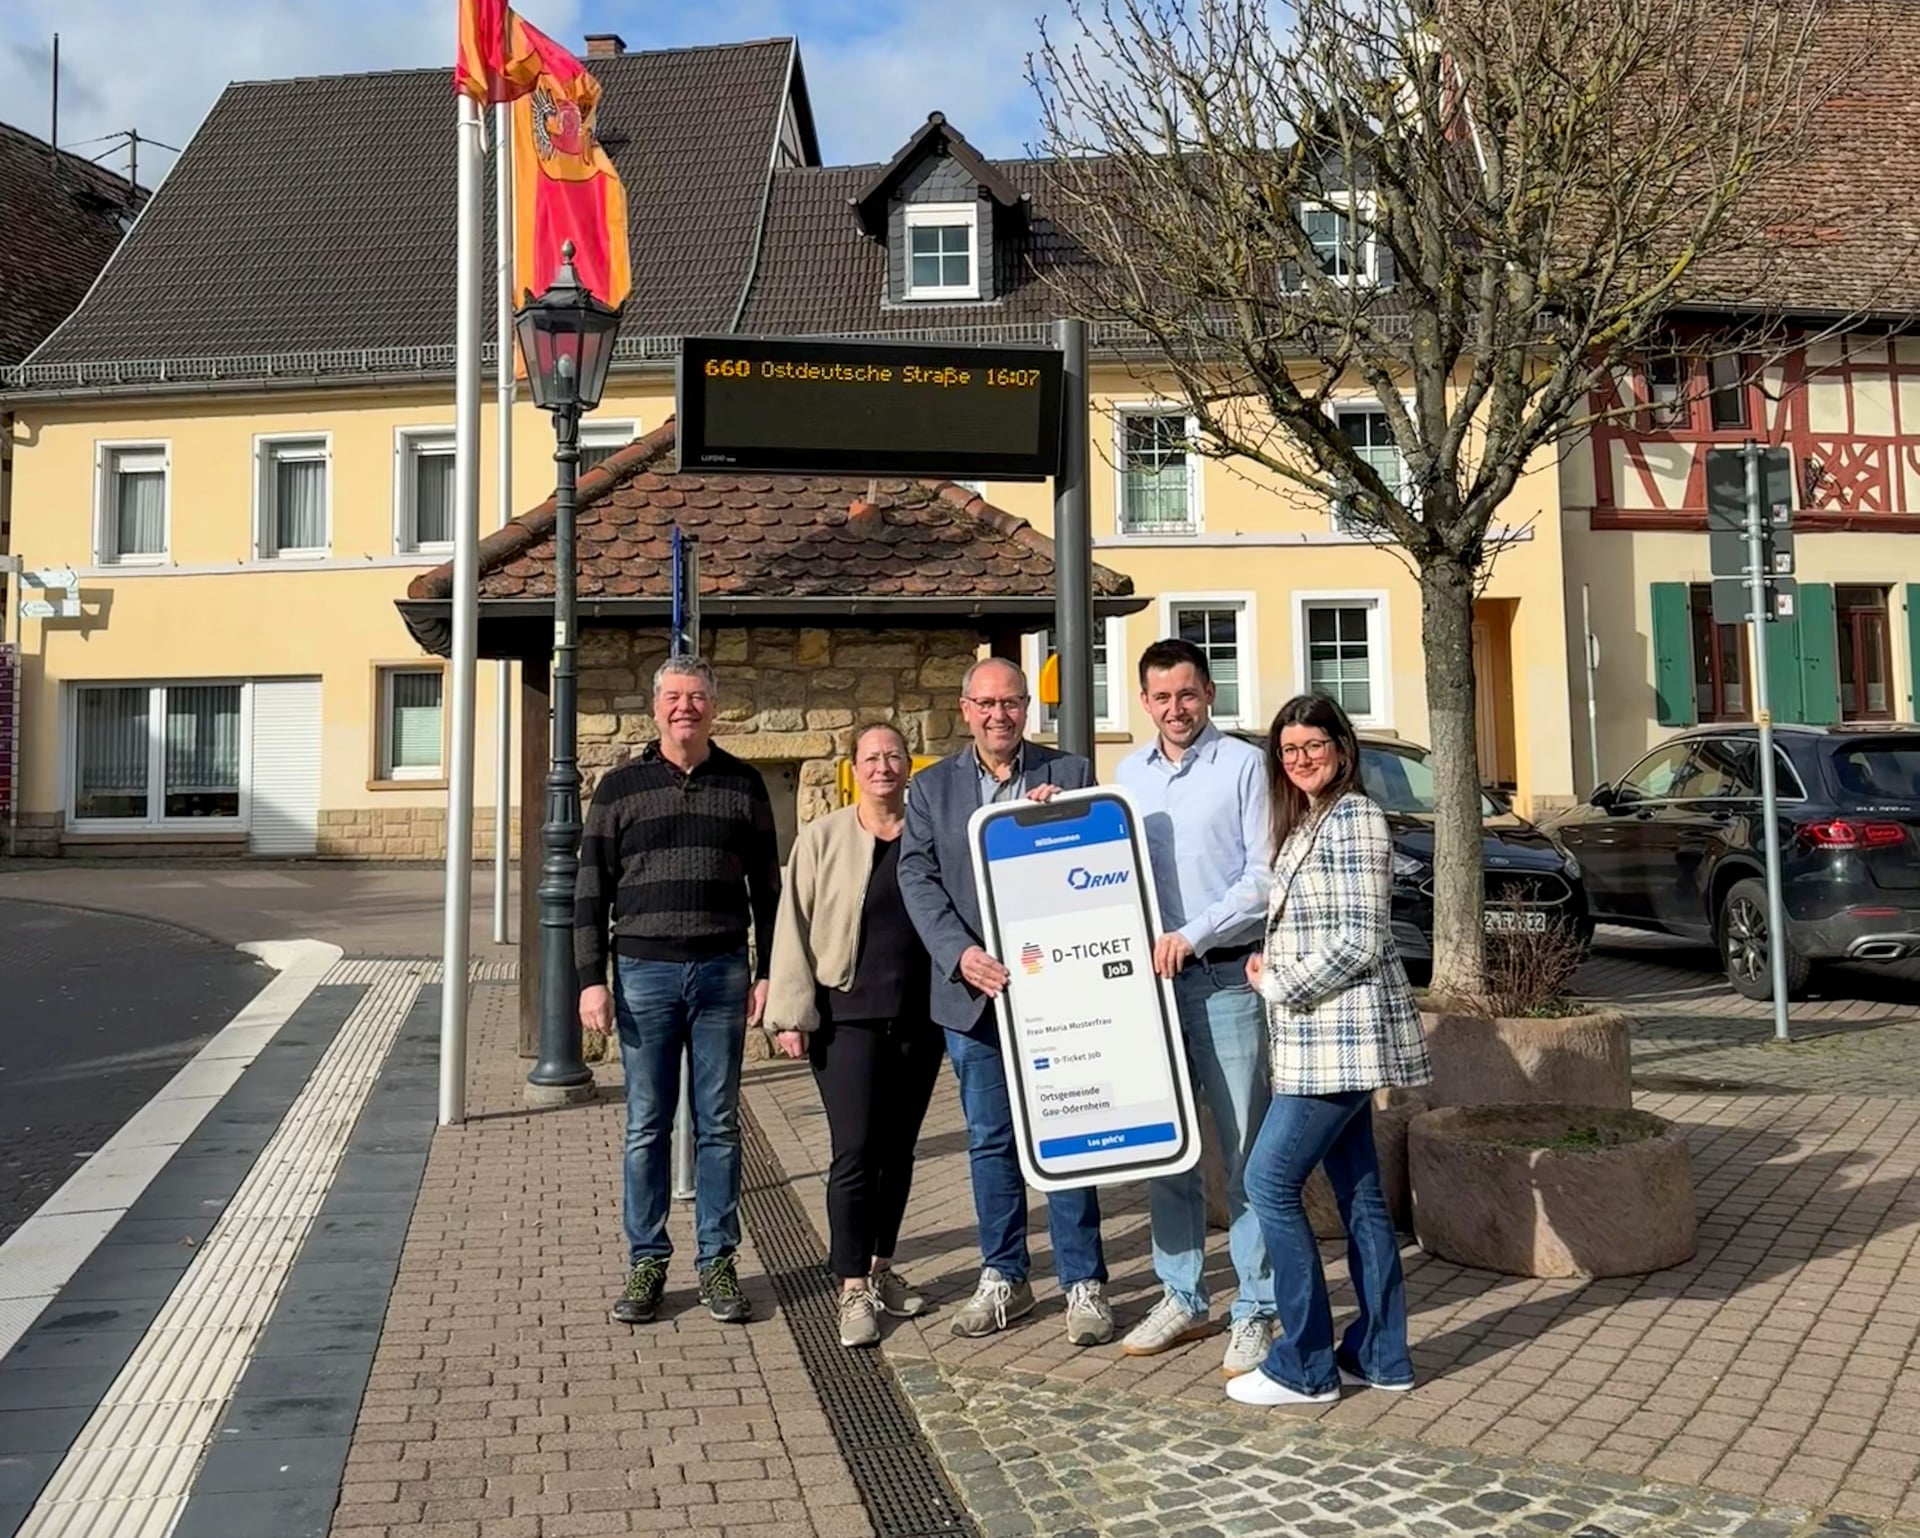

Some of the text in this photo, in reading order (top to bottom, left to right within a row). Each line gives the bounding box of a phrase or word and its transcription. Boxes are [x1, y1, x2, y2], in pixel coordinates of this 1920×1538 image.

[705, 358, 1041, 388] 660 Ostdeutsche Straße 16:07
[1090, 870, 1130, 888] RNN
[1052, 937, 1132, 963] D-TICKET
[1107, 962, 1129, 978] Job
[1045, 1024, 1068, 1034] Maria
[1069, 1018, 1112, 1030] Musterfrau
[1053, 1051, 1102, 1065] D-Ticket Job
[1040, 1086, 1100, 1102] Ortsgemeinde
[1042, 1100, 1110, 1116] Gau-Odernheim
